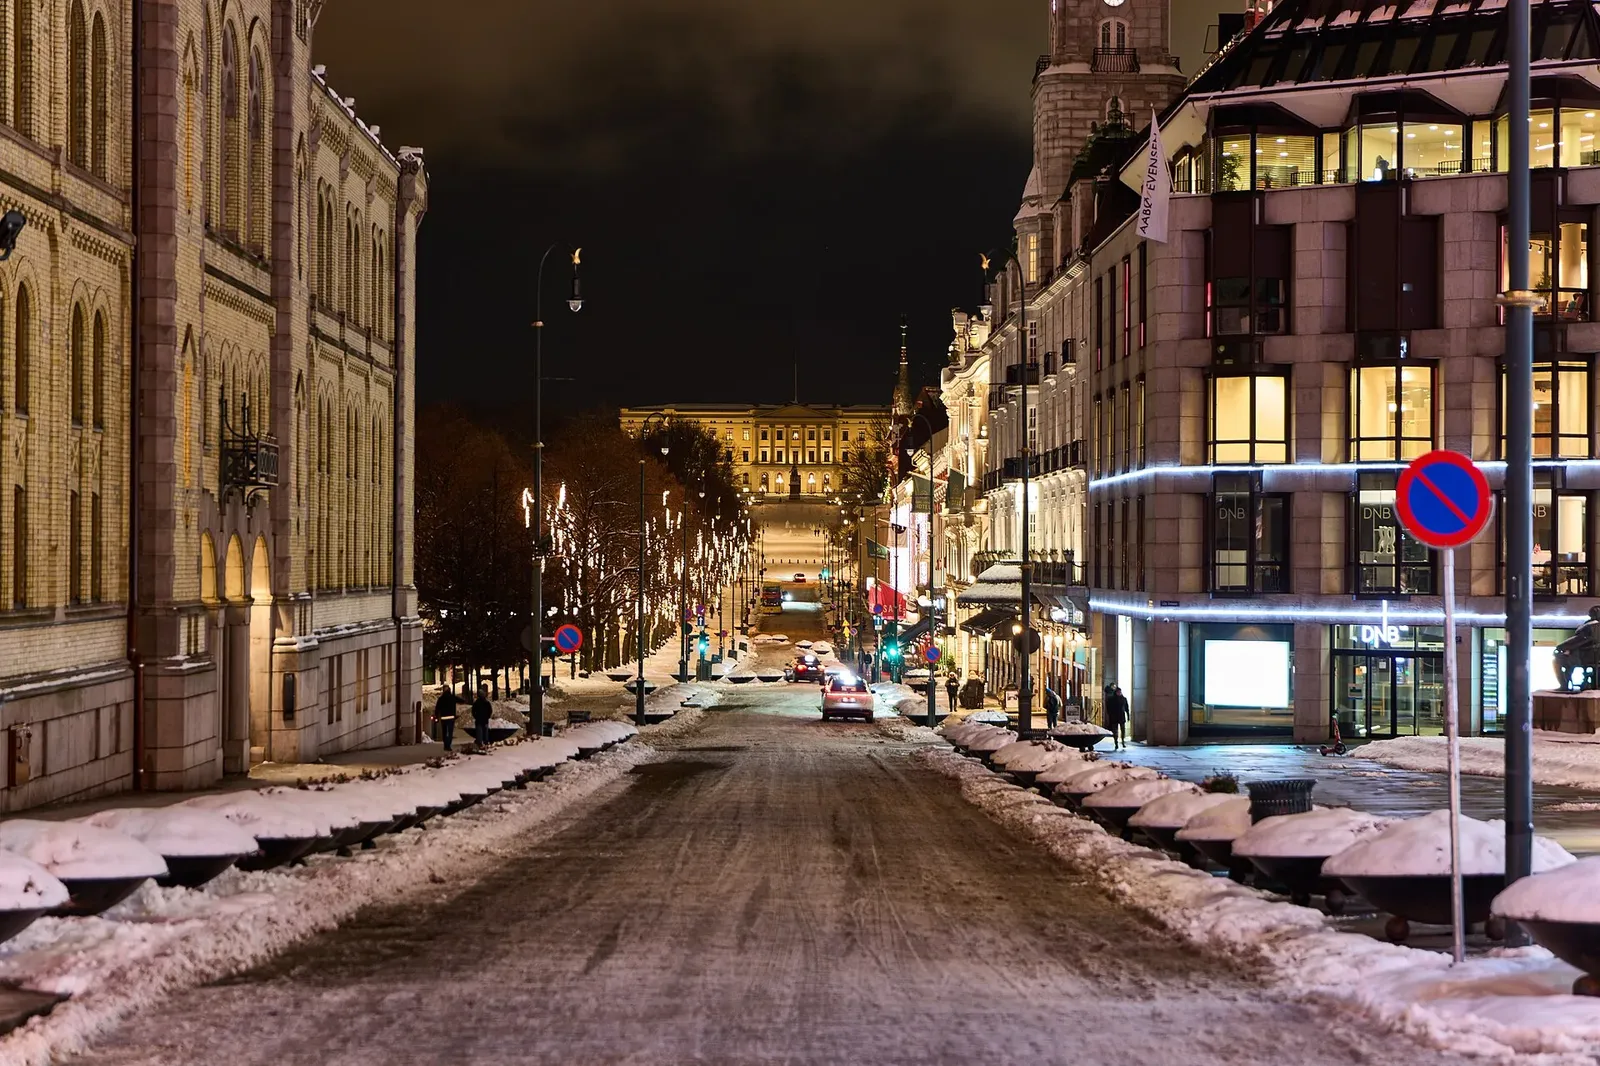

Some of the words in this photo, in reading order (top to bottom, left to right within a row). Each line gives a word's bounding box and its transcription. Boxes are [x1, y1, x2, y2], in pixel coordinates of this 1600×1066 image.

[1219, 507, 1246, 520] DNB
[1363, 507, 1391, 520] DNB
[882, 604, 904, 613] SAE
[1361, 625, 1400, 648] DNB
